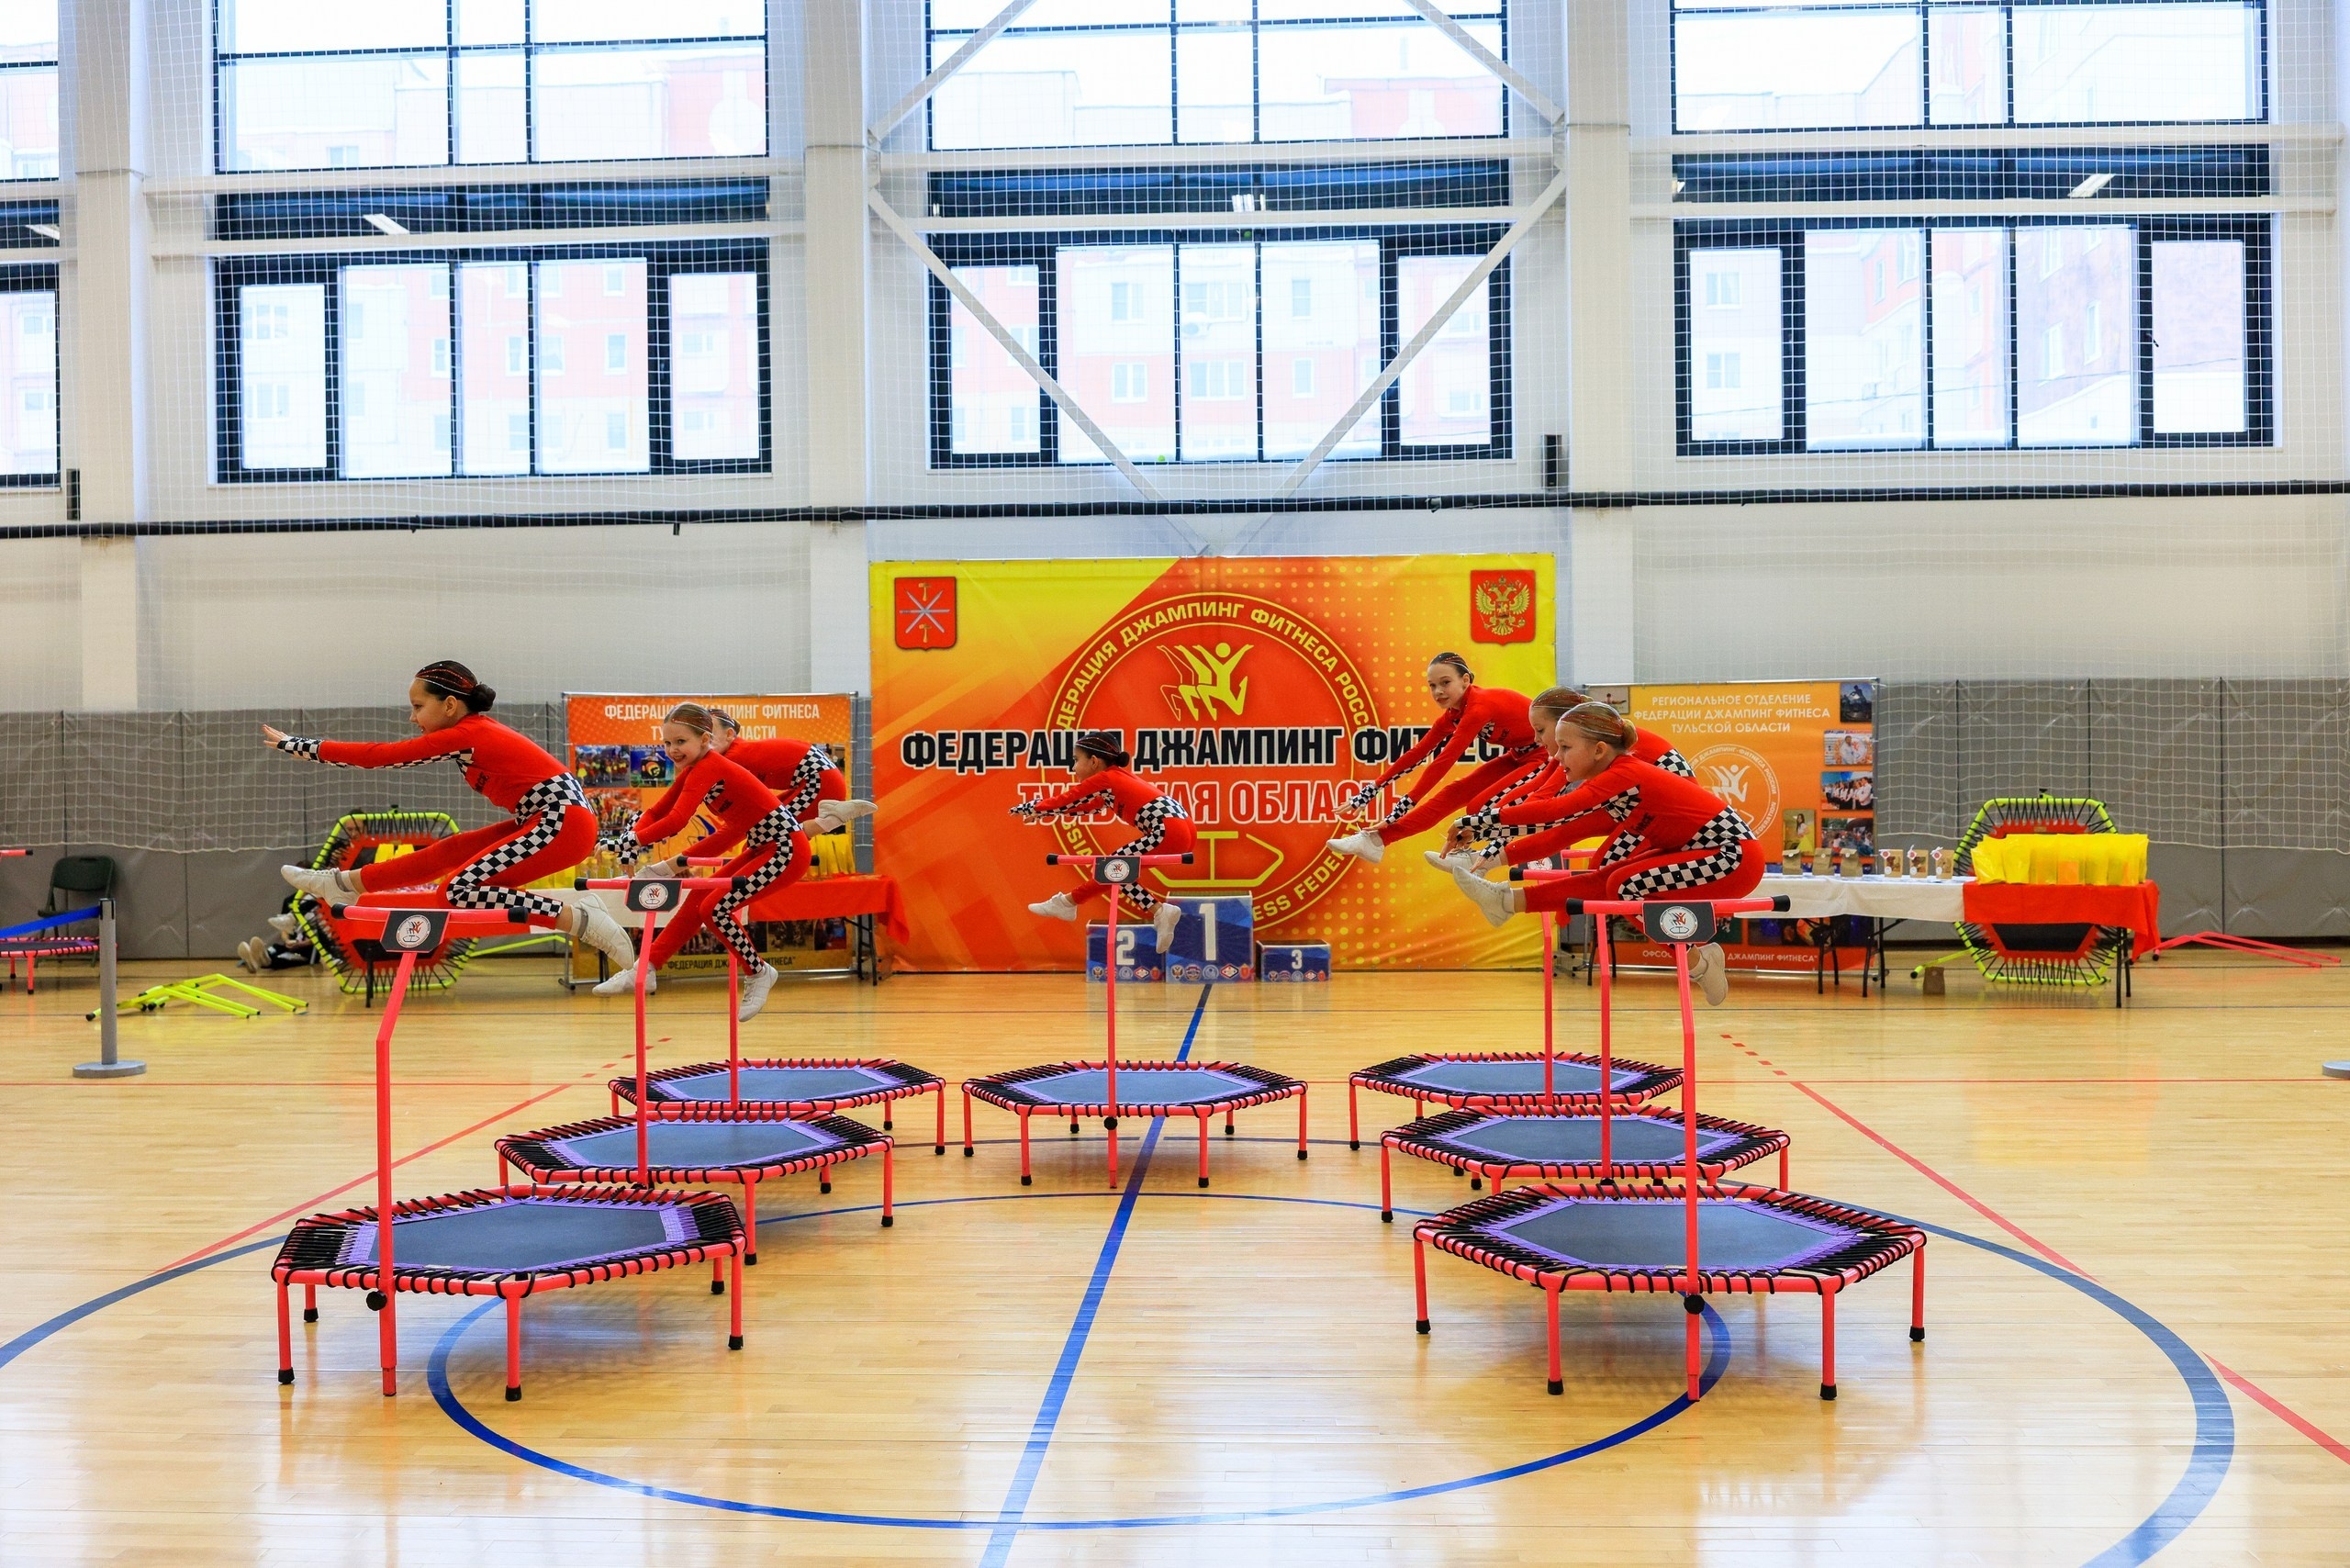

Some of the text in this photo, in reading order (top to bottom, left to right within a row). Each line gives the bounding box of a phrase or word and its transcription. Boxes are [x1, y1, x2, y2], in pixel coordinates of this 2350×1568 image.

[1056, 601, 1371, 731] ДЕРАЦИЯ ДЖАМПИНГ ФИТНЕСА РОСС
[1652, 694, 1811, 706] РЕГИОНАЛЬНОЕ ОТДЕЛЕНИЕ
[604, 704, 677, 722] ФЕДЕРАЦИ
[762, 703, 821, 720] ФИТНЕСА
[1633, 708, 1830, 721] ФЕДЕРАЦИИ ДЖАМПИНГ ФИТНЕСА
[1672, 722, 1791, 734] ТУЛЬСКОЙ ОБЛАСТИ
[1132, 726, 1345, 774] ДЖАМПИНГ
[1198, 902, 1217, 961] 1
[1116, 930, 1136, 966] 2
[1727, 952, 1775, 962] ДЖАМПИНГ
[1291, 949, 1303, 969] 3
